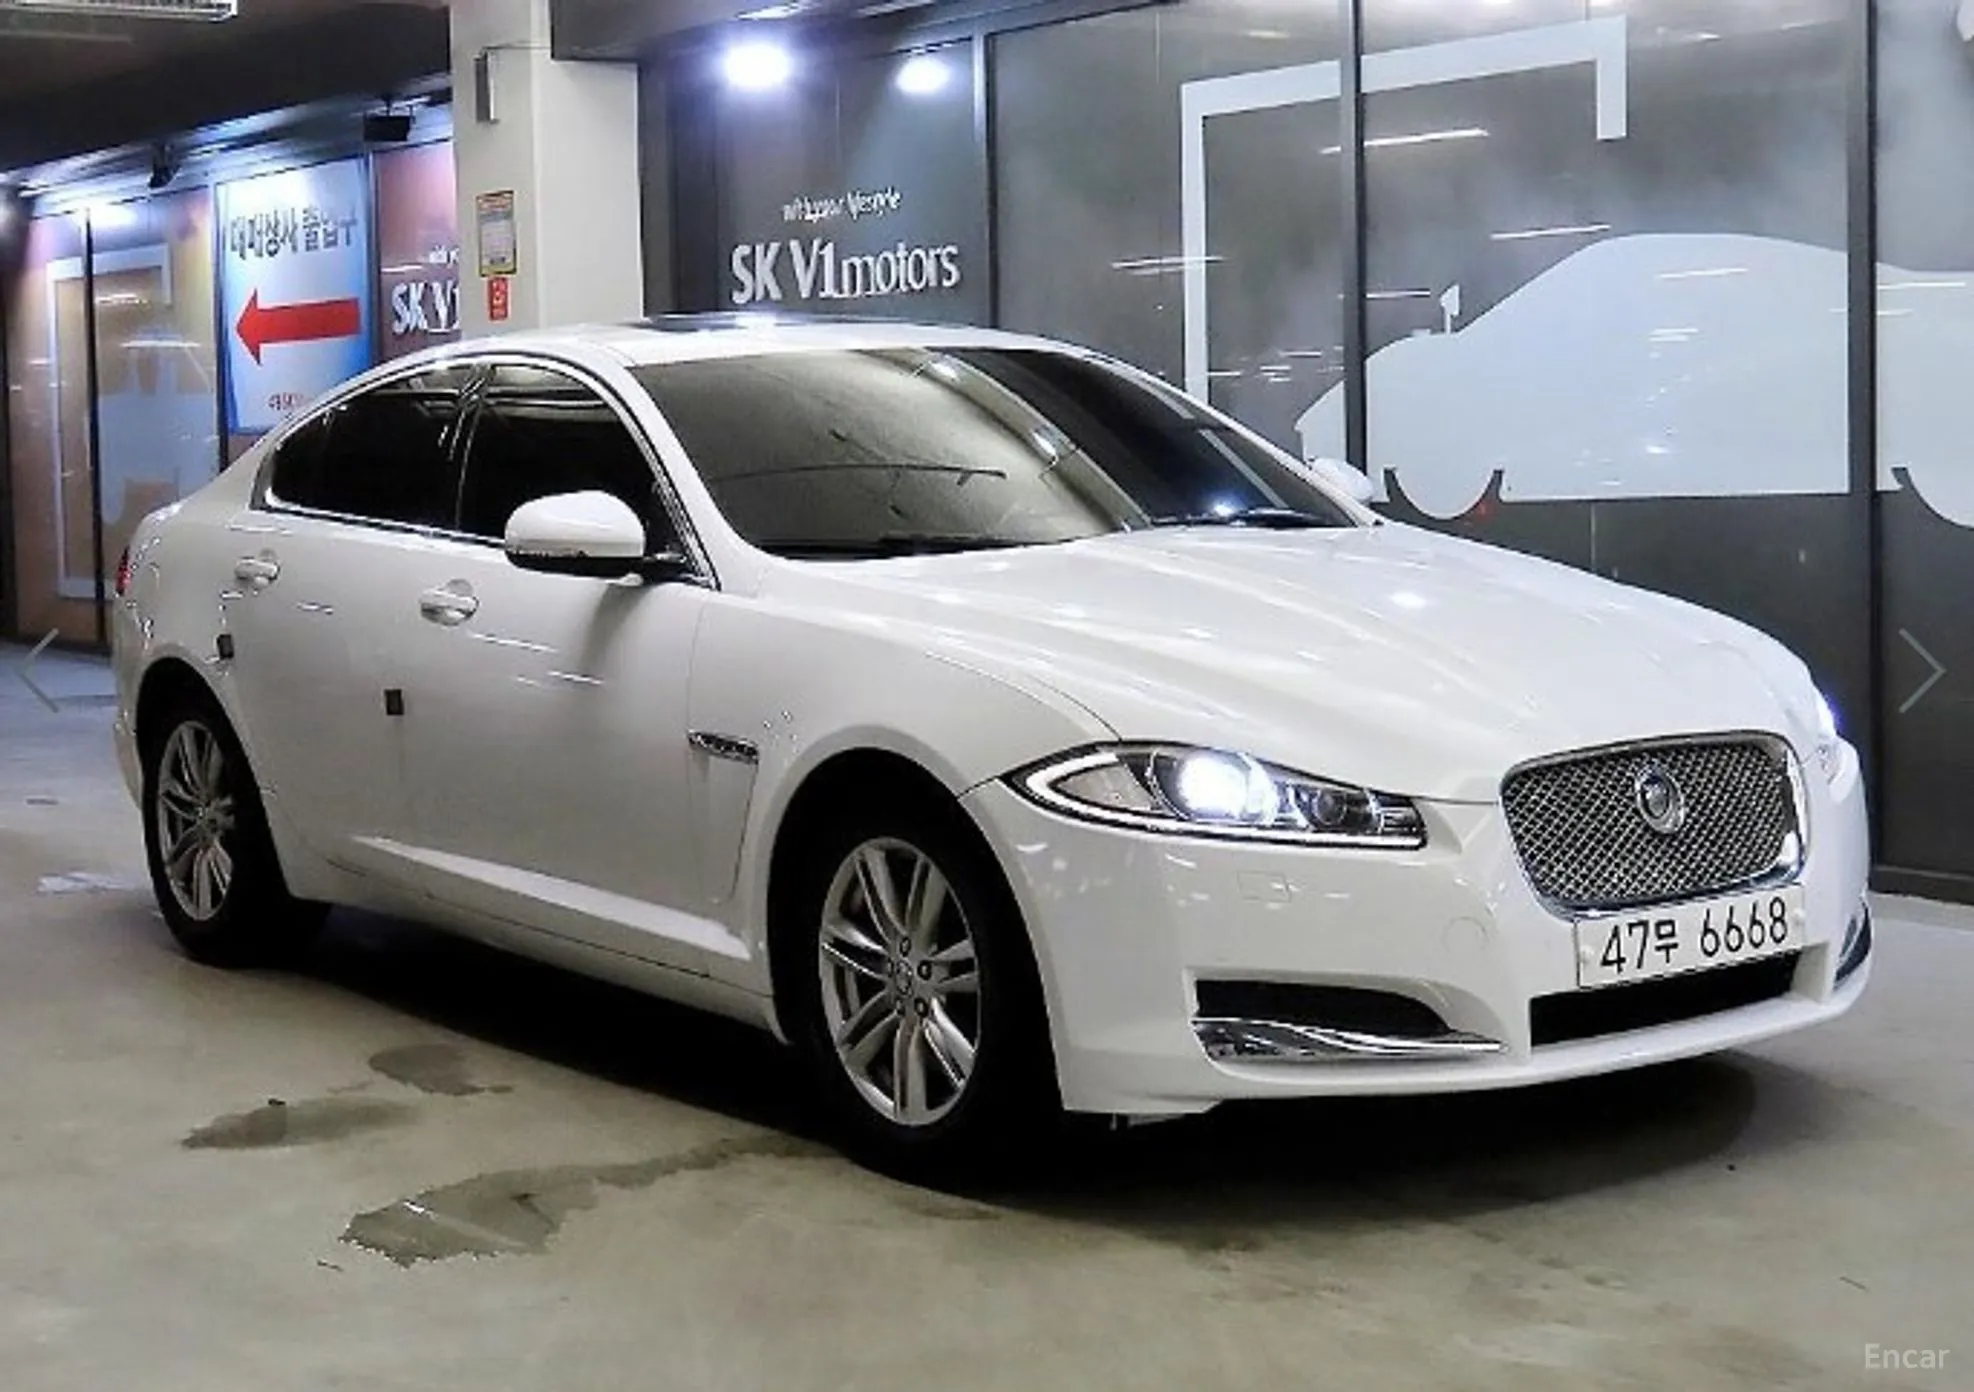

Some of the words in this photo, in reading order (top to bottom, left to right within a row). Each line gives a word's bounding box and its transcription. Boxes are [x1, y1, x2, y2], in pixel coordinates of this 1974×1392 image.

[732, 244, 783, 305] SK
[392, 282, 428, 335] SK
[1601, 918, 1680, 974] 47무
[1700, 896, 1788, 957] 6668
